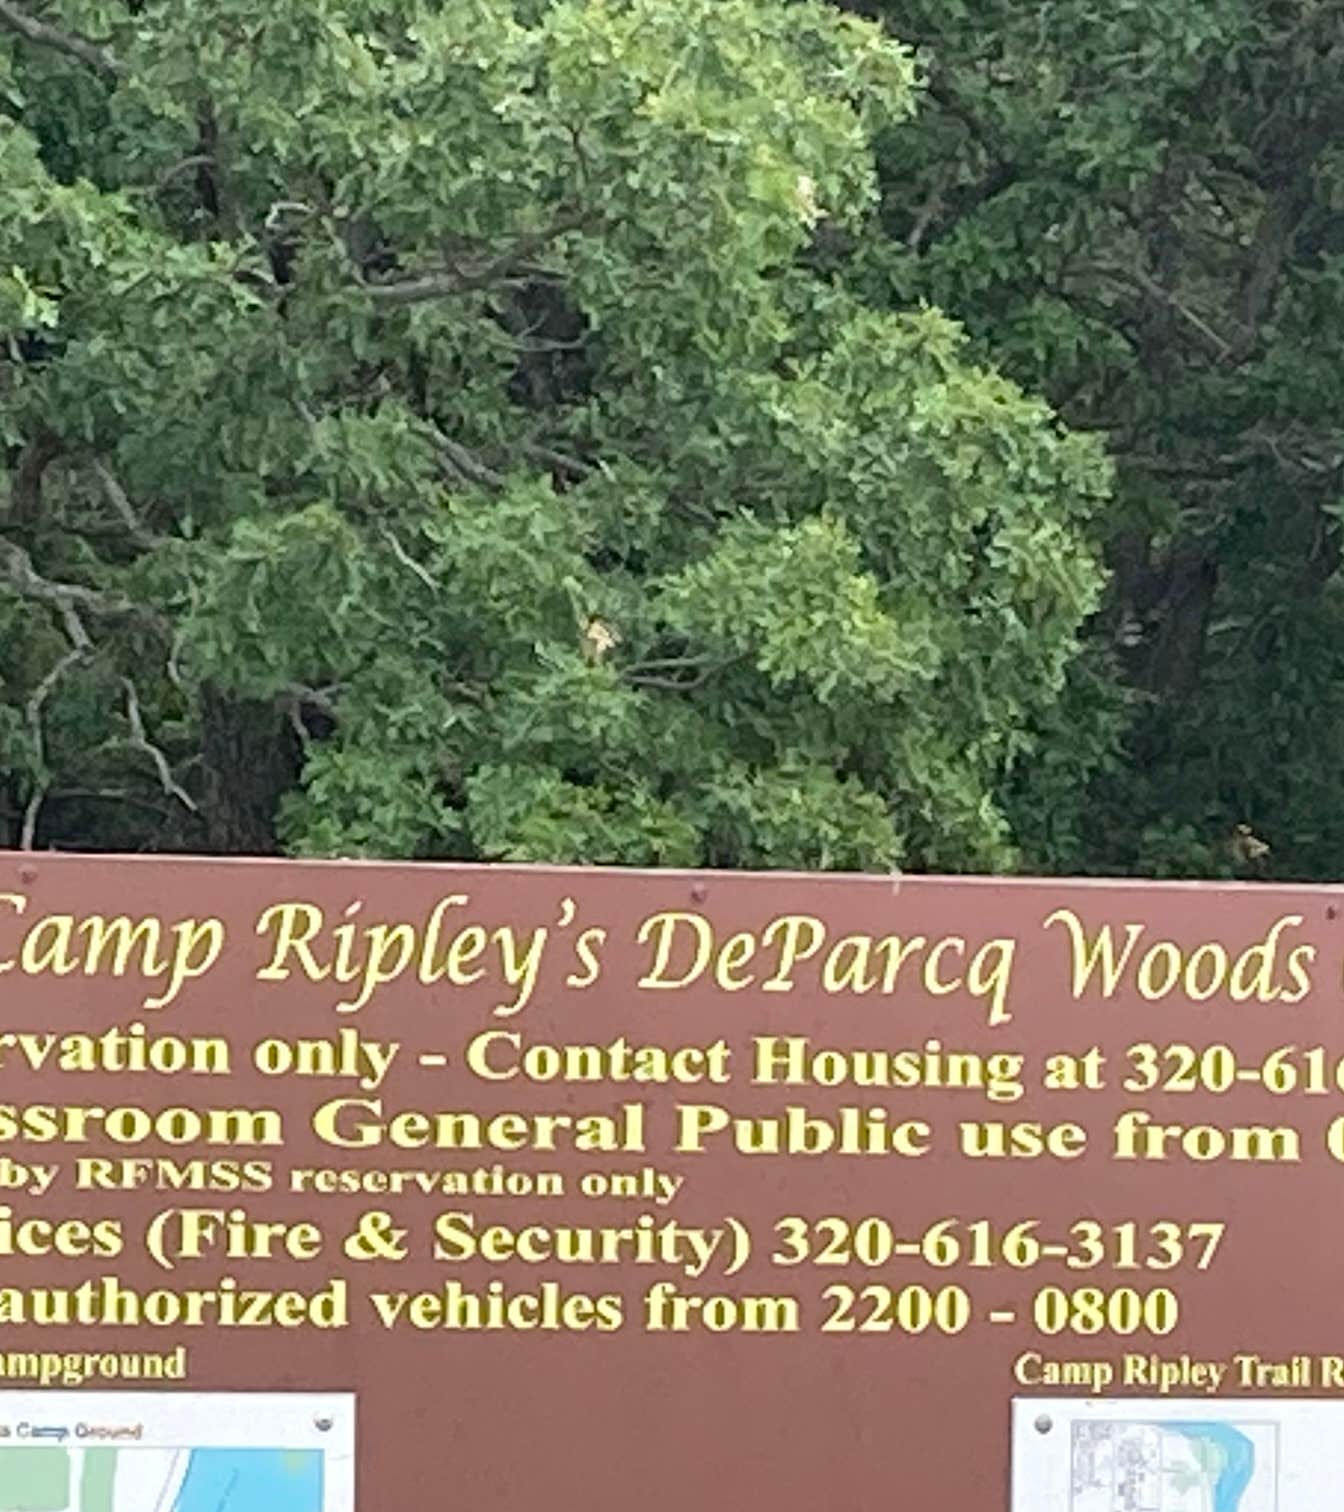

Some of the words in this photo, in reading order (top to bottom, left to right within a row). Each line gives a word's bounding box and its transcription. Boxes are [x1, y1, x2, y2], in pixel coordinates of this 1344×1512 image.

[256, 895, 606, 1017] Ripley's
[637, 912, 1015, 1026] DeParcq
[1044, 910, 1316, 1002] Woods
[255, 1028, 400, 1091] only
[467, 1031, 732, 1083] Contact
[751, 1036, 1024, 1102] Housing
[1044, 1046, 1106, 1089] at
[313, 1098, 645, 1152] General
[673, 1105, 930, 1156] Public
[960, 1122, 1086, 1158] use
[1114, 1111, 1301, 1161] from
[76, 1158, 272, 1192] RFMSS
[291, 1165, 564, 1195] reservation
[581, 1168, 684, 1205] only
[147, 1209, 321, 1269] (Fire
[344, 1211, 408, 1260] &
[434, 1212, 751, 1277] Security)
[773, 1217, 1224, 1269] 320-616-3137
[370, 1280, 624, 1331] vehicles
[644, 1282, 800, 1331] from
[821, 1285, 970, 1334] 2200
[1034, 1286, 1178, 1334] 0800
[1015, 1352, 1112, 1391] Camp
[1125, 1355, 1227, 1392] Ripley
[1234, 1355, 1311, 1386] Trail
